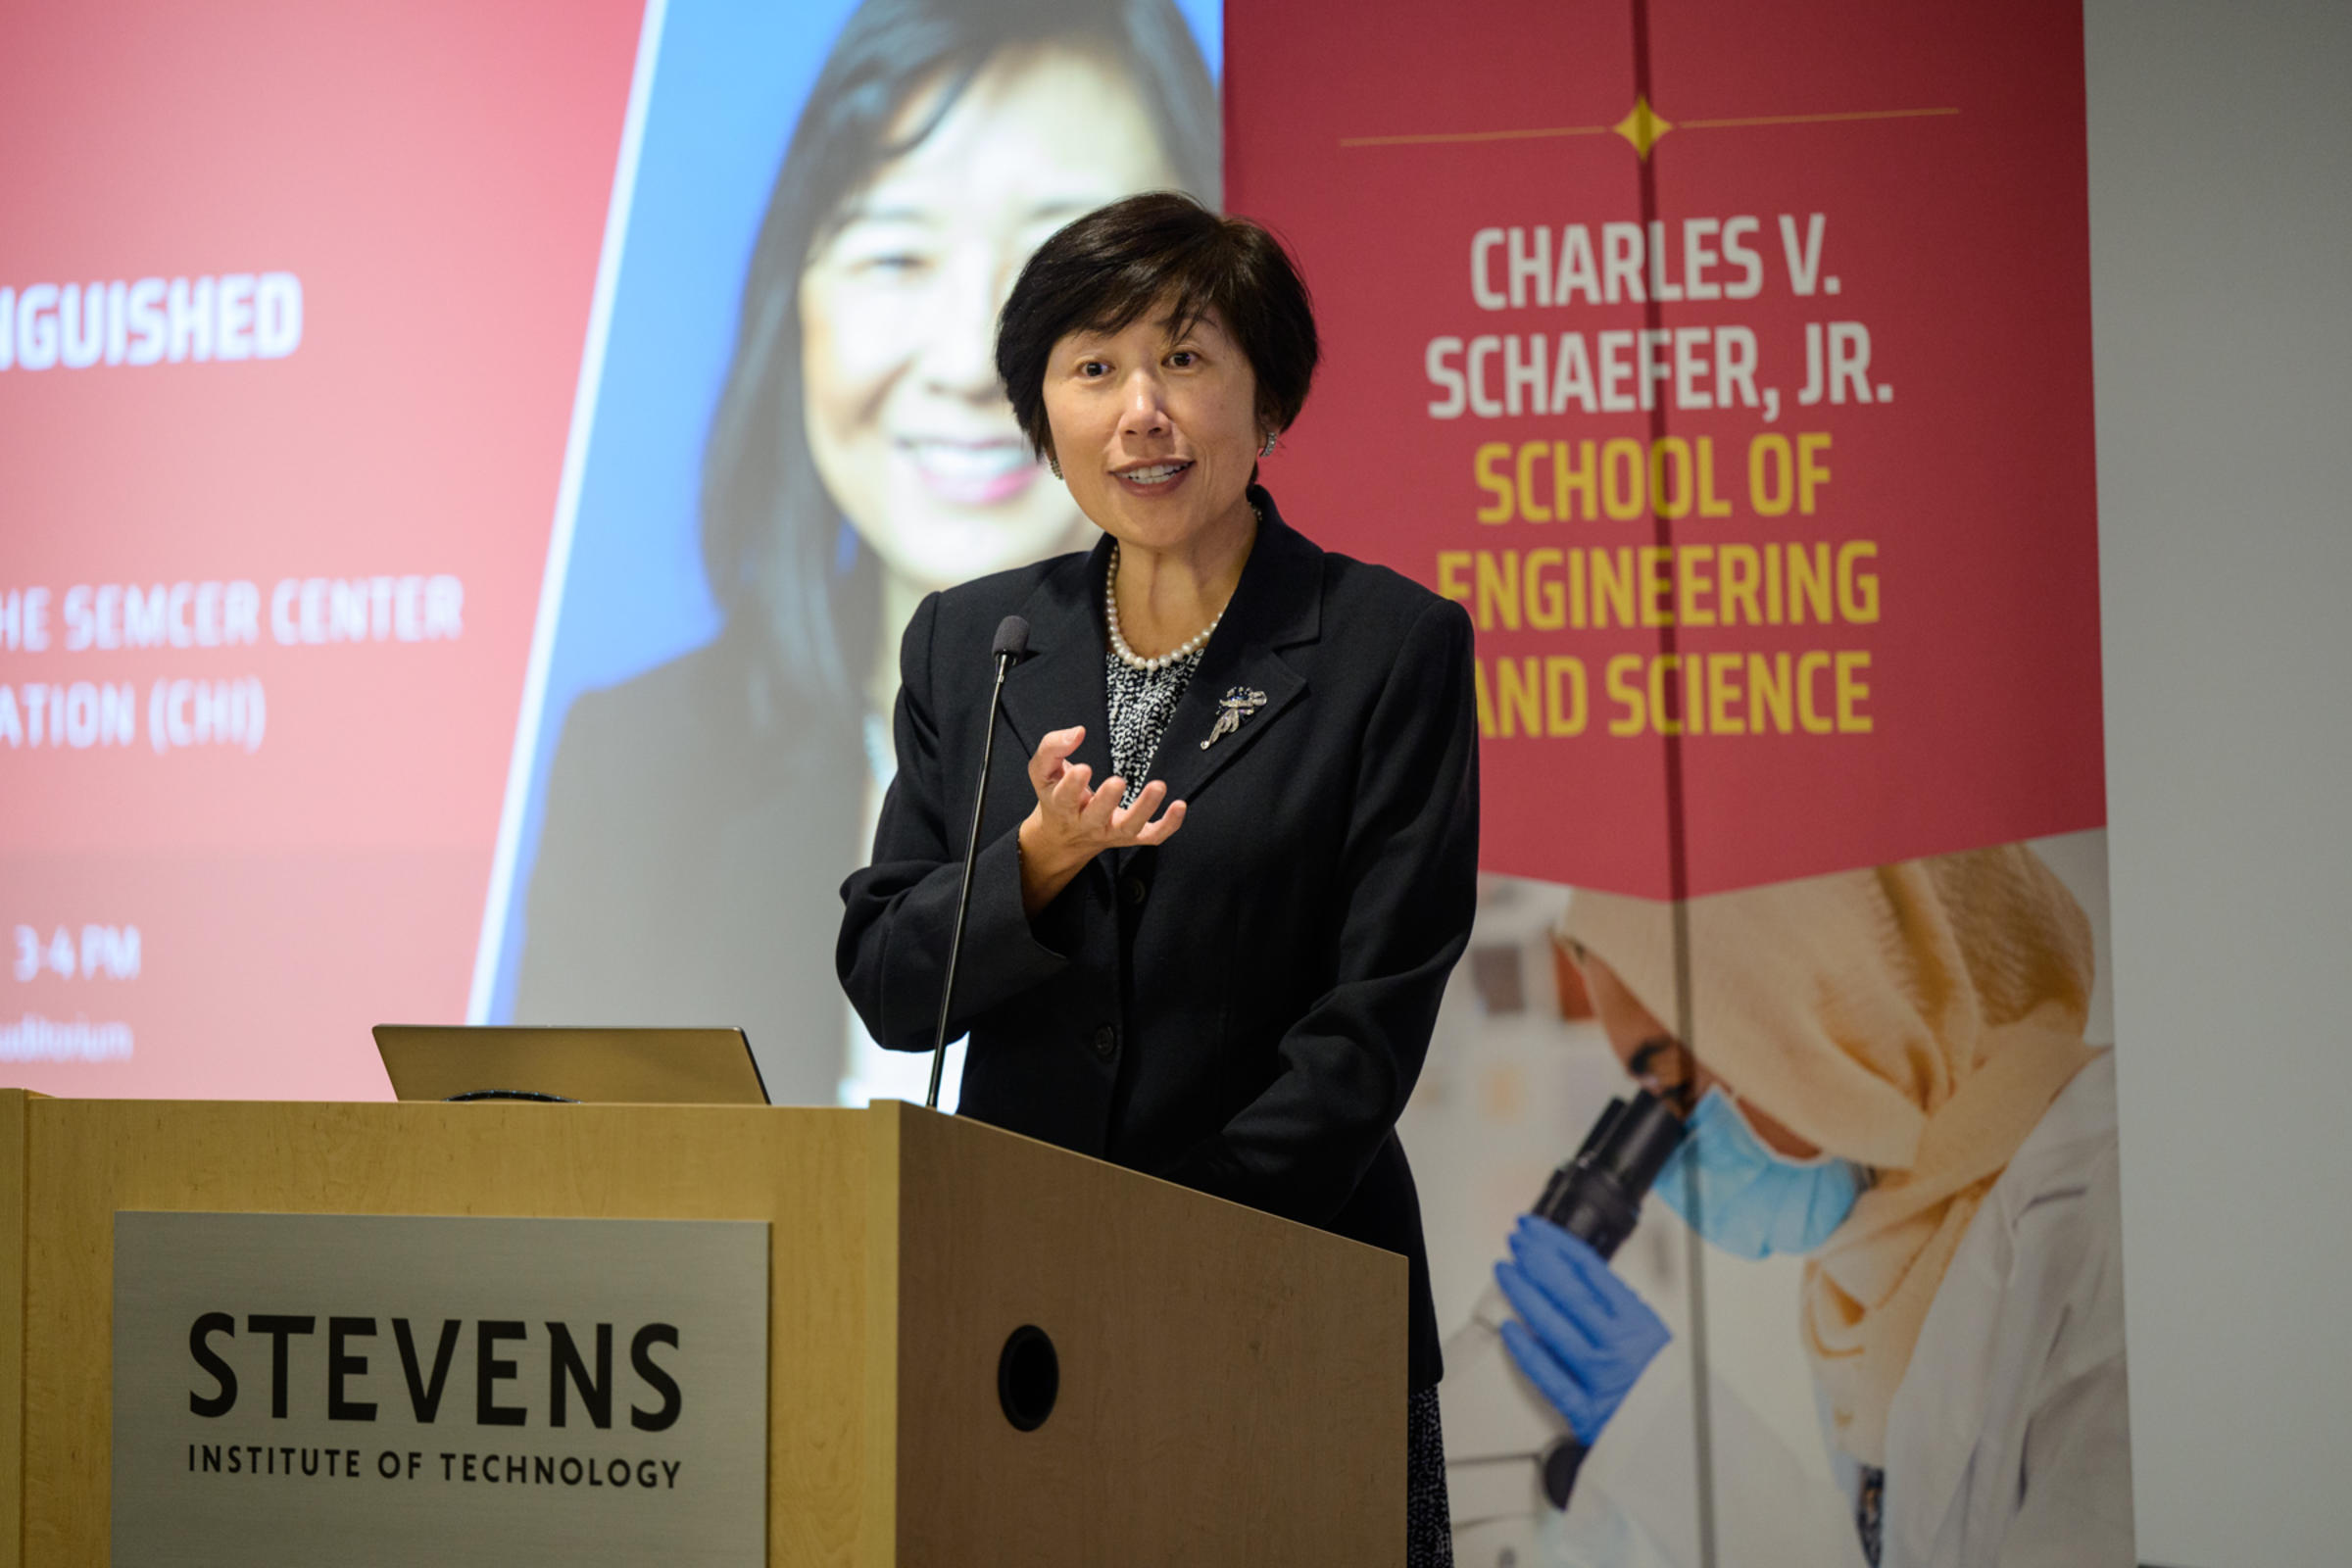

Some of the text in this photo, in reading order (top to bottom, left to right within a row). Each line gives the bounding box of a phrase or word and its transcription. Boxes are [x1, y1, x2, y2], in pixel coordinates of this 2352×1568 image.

[1470, 213, 1840, 311] CHARLES V.
[1425, 321, 1893, 422] SCHAEFER, JR.
[1475, 432, 1832, 523] SCHOOL OF
[64, 580, 260, 650] SEMCER
[271, 575, 464, 645] CENTER
[1438, 541, 1880, 631] ENGINEERING
[149, 673, 266, 756] (CHI)
[1605, 651, 1873, 737] SCIENCE
[80, 924, 141, 981] PM
[189, 1311, 682, 1432] STEVENS
[189, 1444, 681, 1490] INSTITUTE OF TECHNOLOGY
